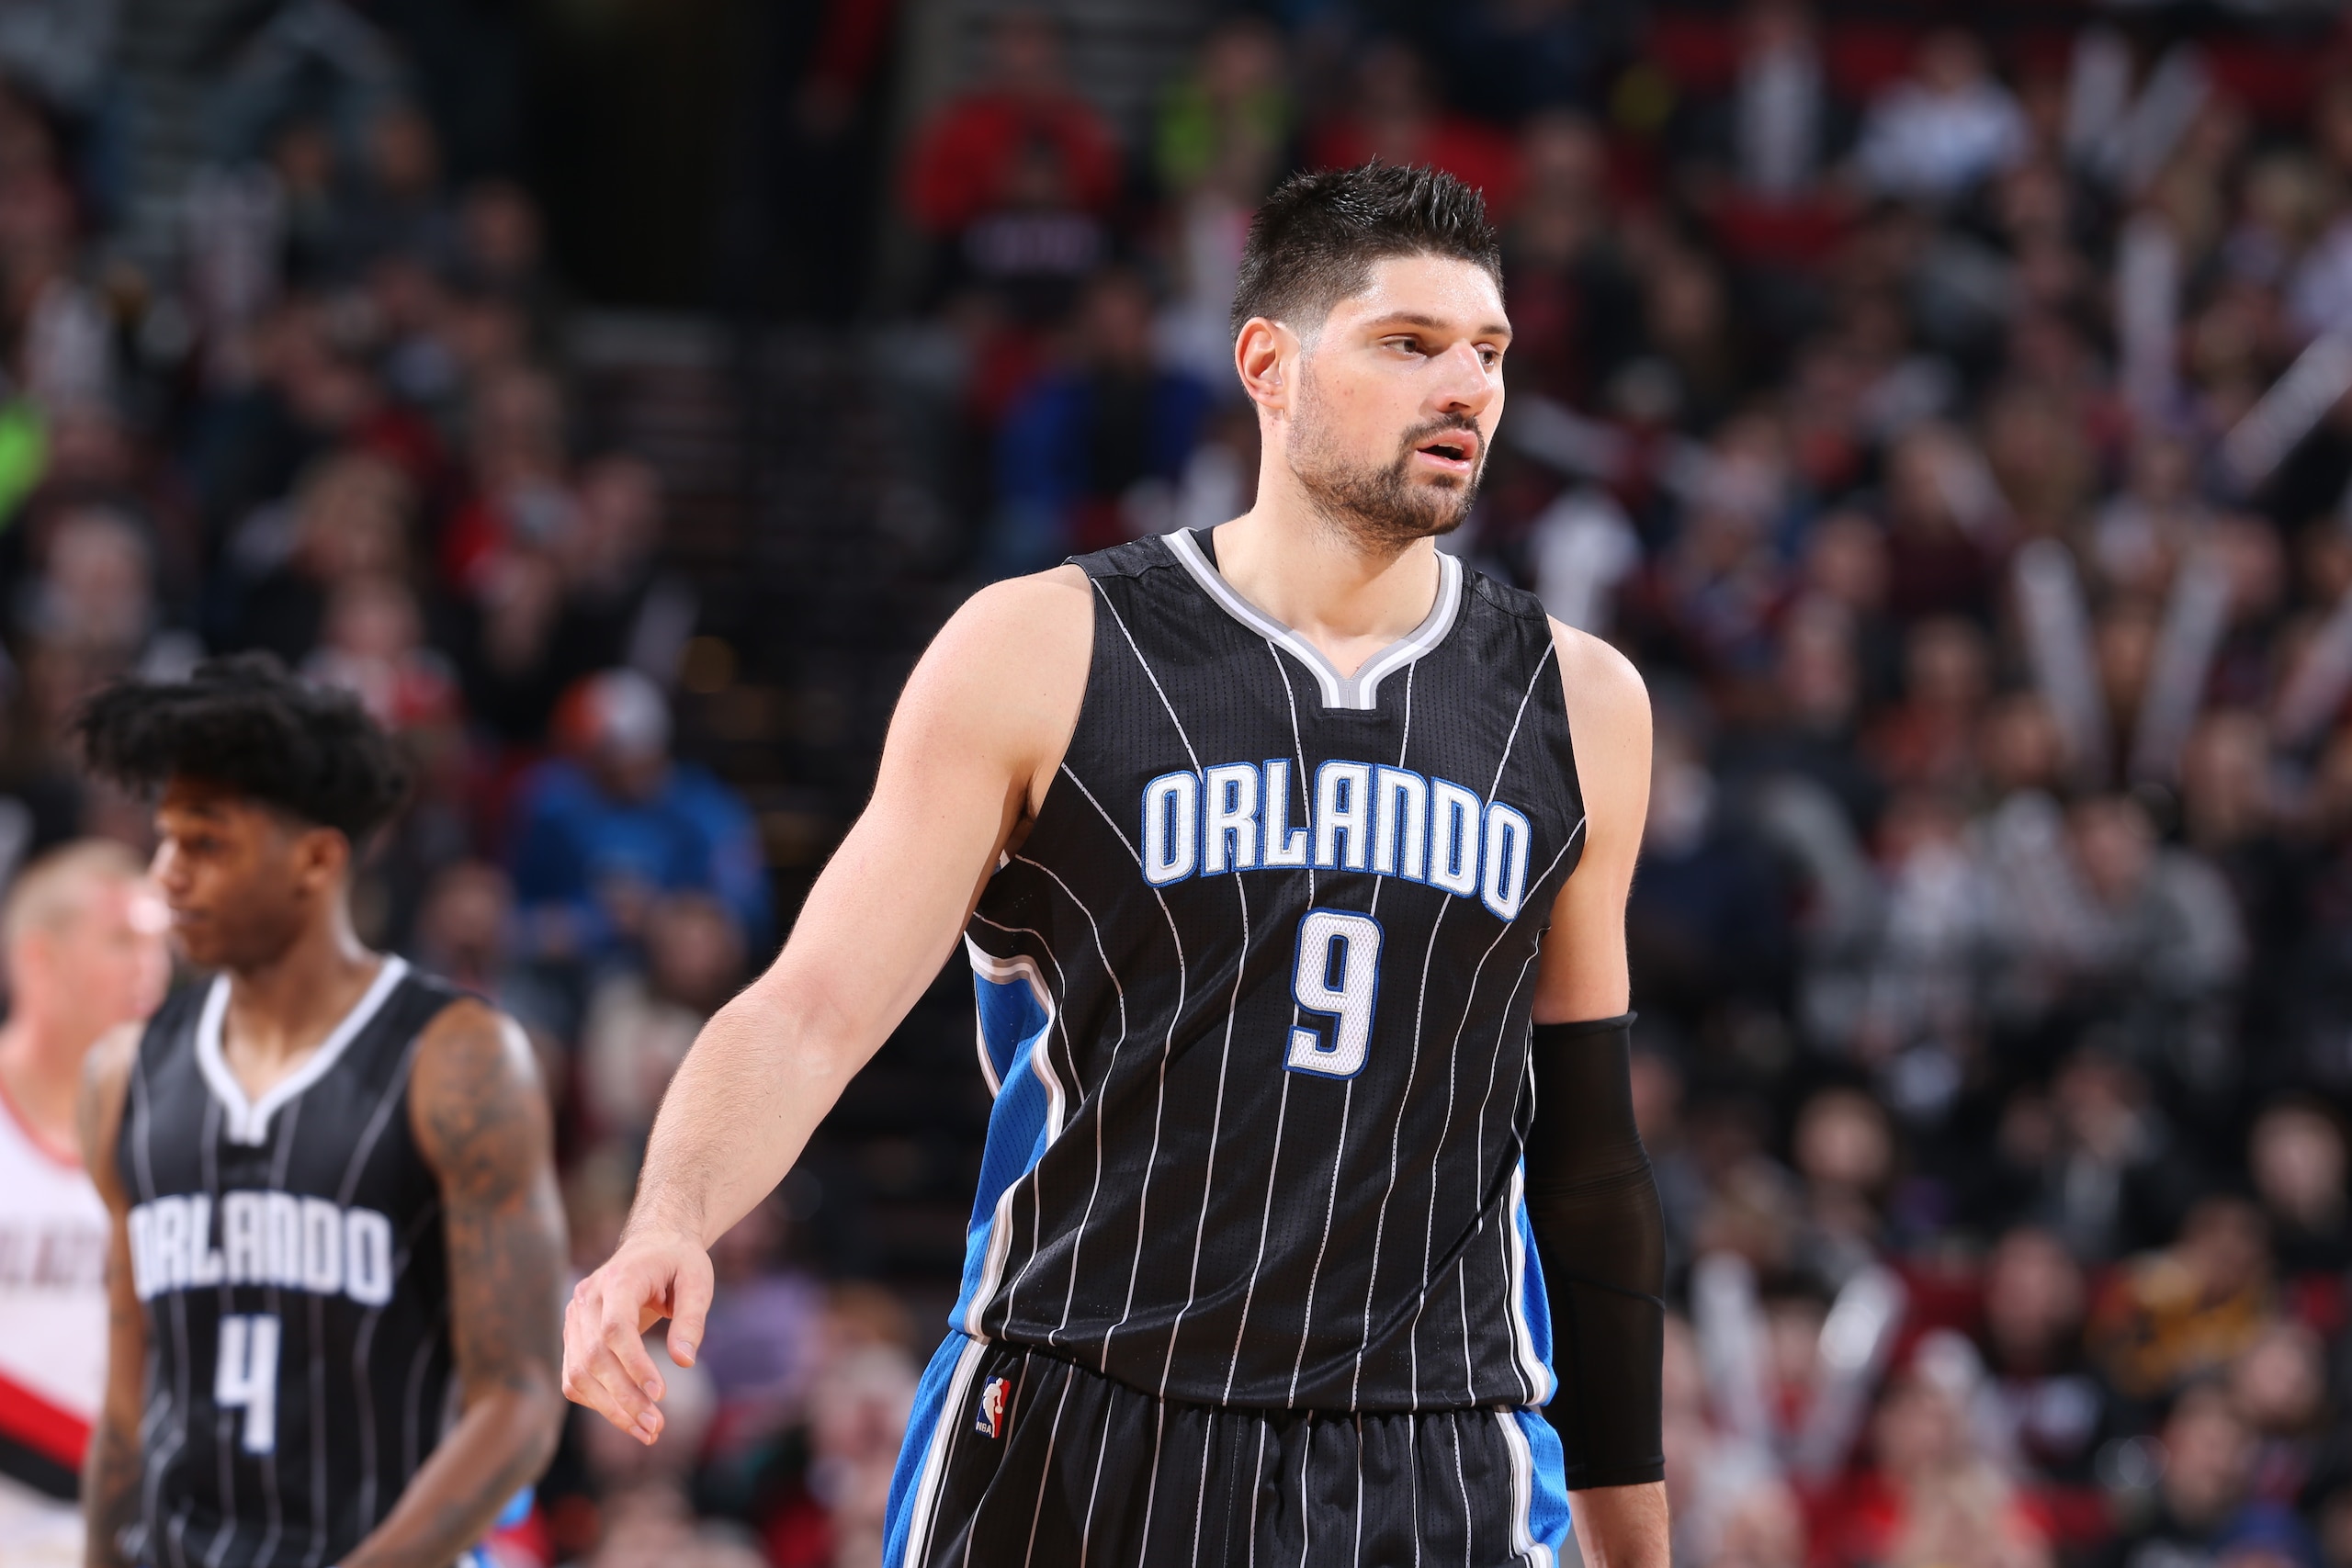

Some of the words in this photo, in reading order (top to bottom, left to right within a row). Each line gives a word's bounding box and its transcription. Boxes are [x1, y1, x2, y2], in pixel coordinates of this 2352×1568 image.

[1142, 759, 1532, 922] ORLANDO
[1283, 908, 1384, 1080] 9
[215, 1314, 280, 1454] 4
[975, 1421, 992, 1435] NBA
